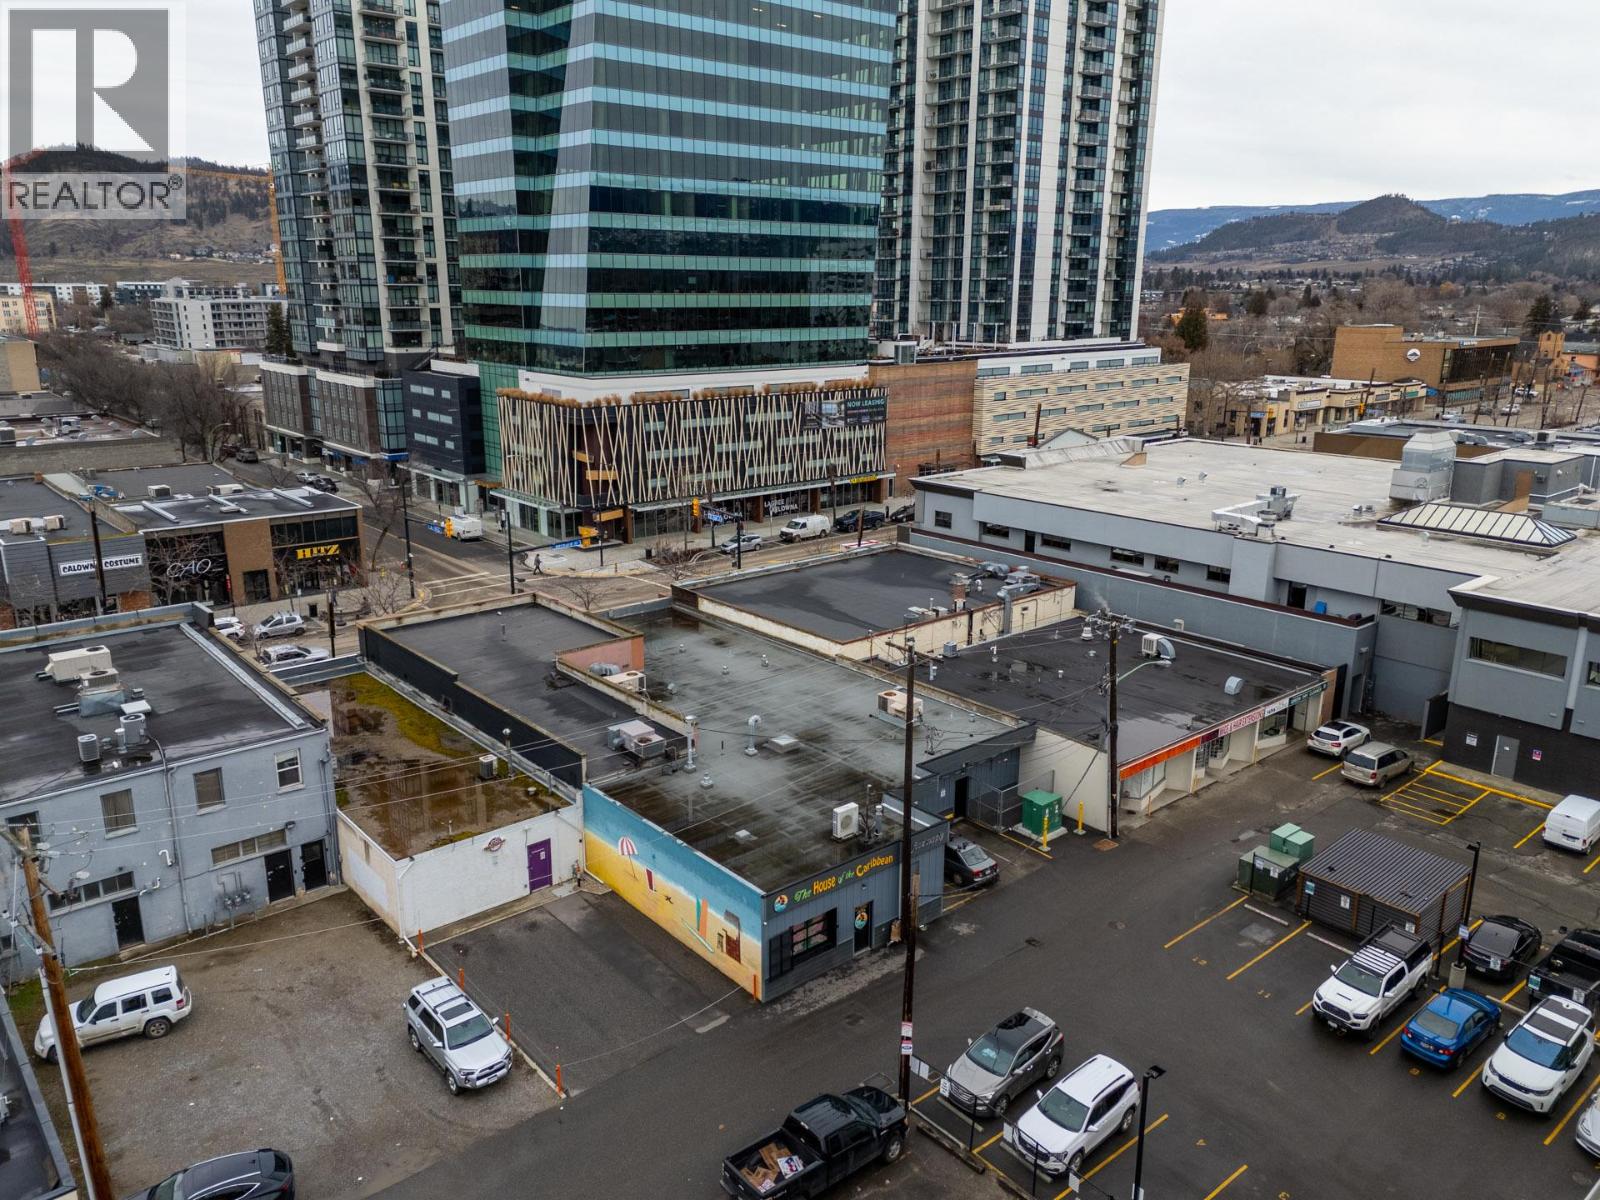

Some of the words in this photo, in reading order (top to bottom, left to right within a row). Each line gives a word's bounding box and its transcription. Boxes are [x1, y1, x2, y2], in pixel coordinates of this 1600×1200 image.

[104, 557, 140, 567] COSTUME
[794, 888, 811, 902] The
[813, 876, 836, 895] House
[838, 871, 847, 884] of
[845, 869, 855, 880] the
[856, 855, 893, 877] Caribbean
